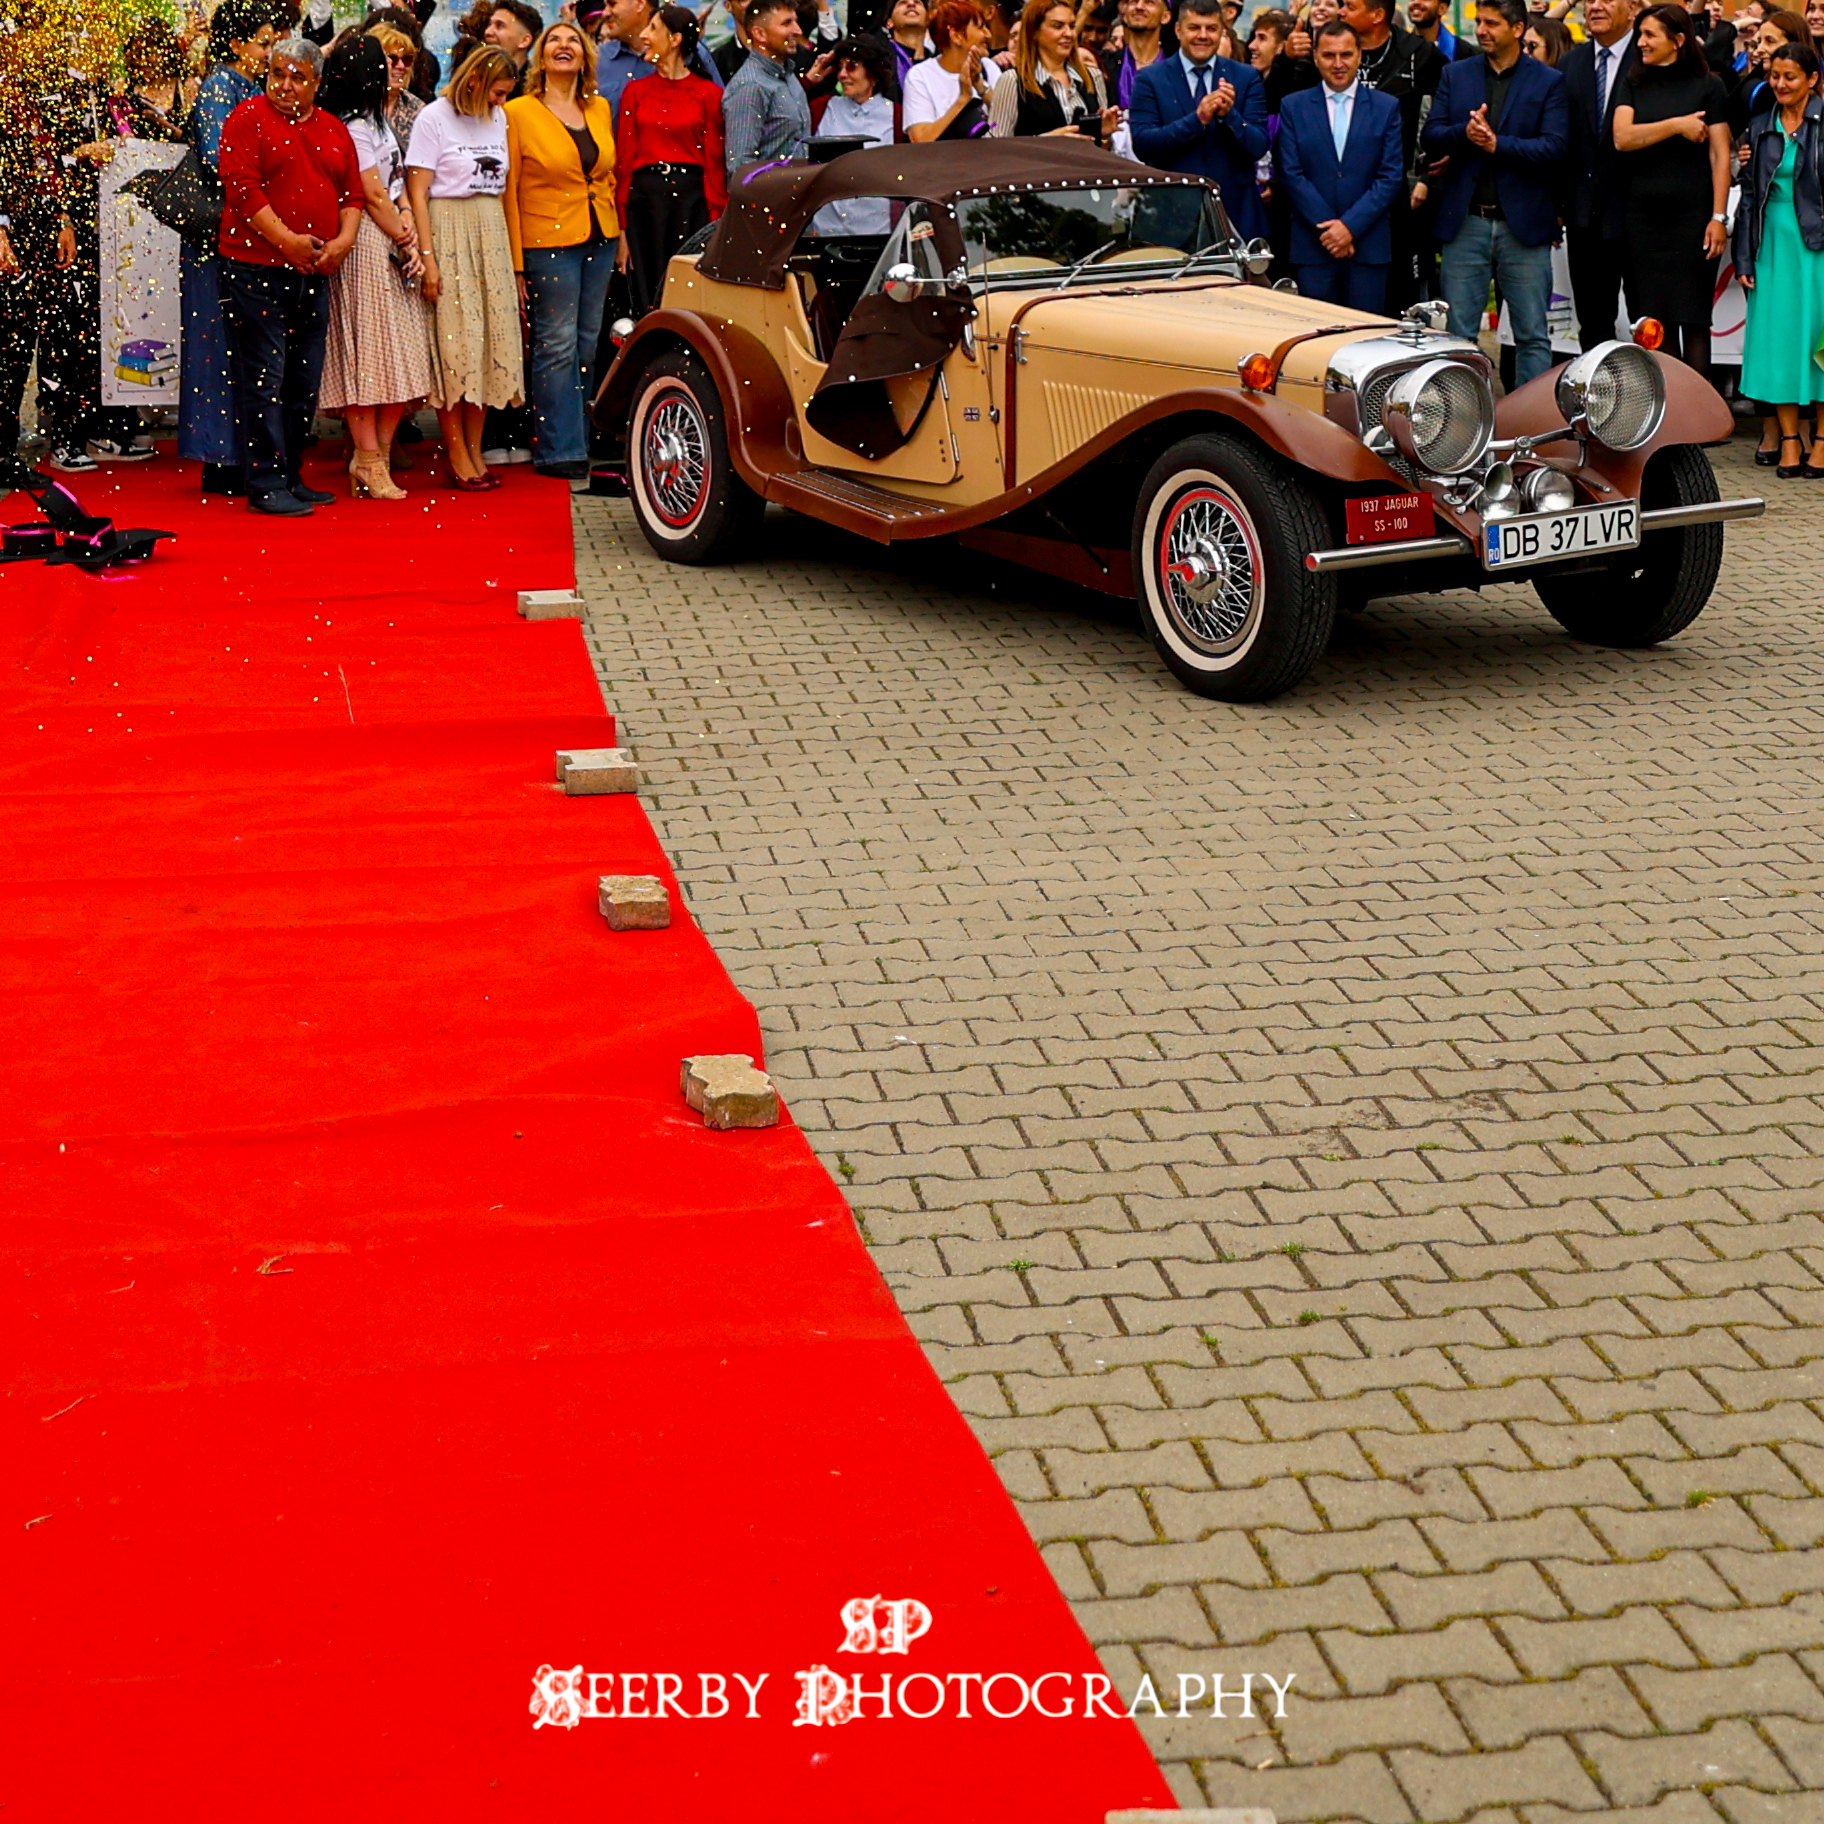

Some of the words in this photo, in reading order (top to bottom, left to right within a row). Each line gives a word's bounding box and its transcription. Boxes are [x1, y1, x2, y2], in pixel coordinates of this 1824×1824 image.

[1360, 500, 1380, 513] 1937
[1384, 496, 1419, 512] JAGUAR
[1503, 524, 1539, 560] DB
[1488, 547, 1500, 561] RO
